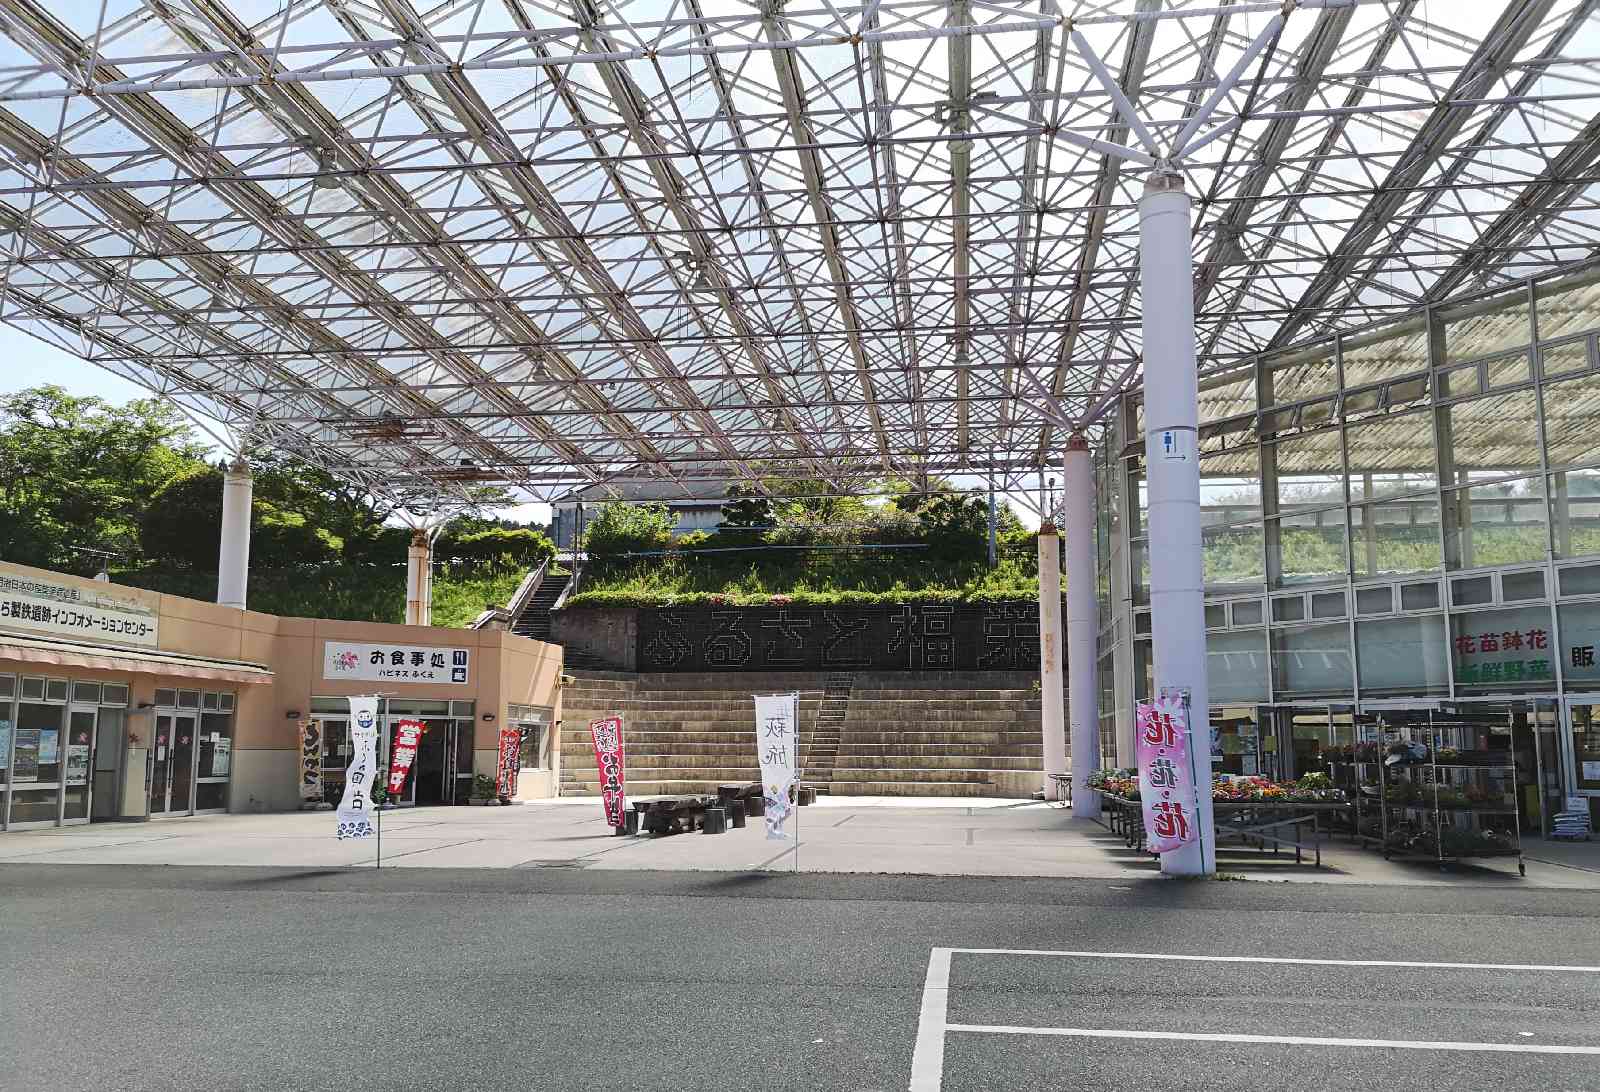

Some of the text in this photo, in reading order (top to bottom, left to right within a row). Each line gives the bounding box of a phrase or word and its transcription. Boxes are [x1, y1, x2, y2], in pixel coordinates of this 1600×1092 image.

[1456, 629, 1548, 654] 花苗鉢花
[370, 650, 445, 668] お食事処
